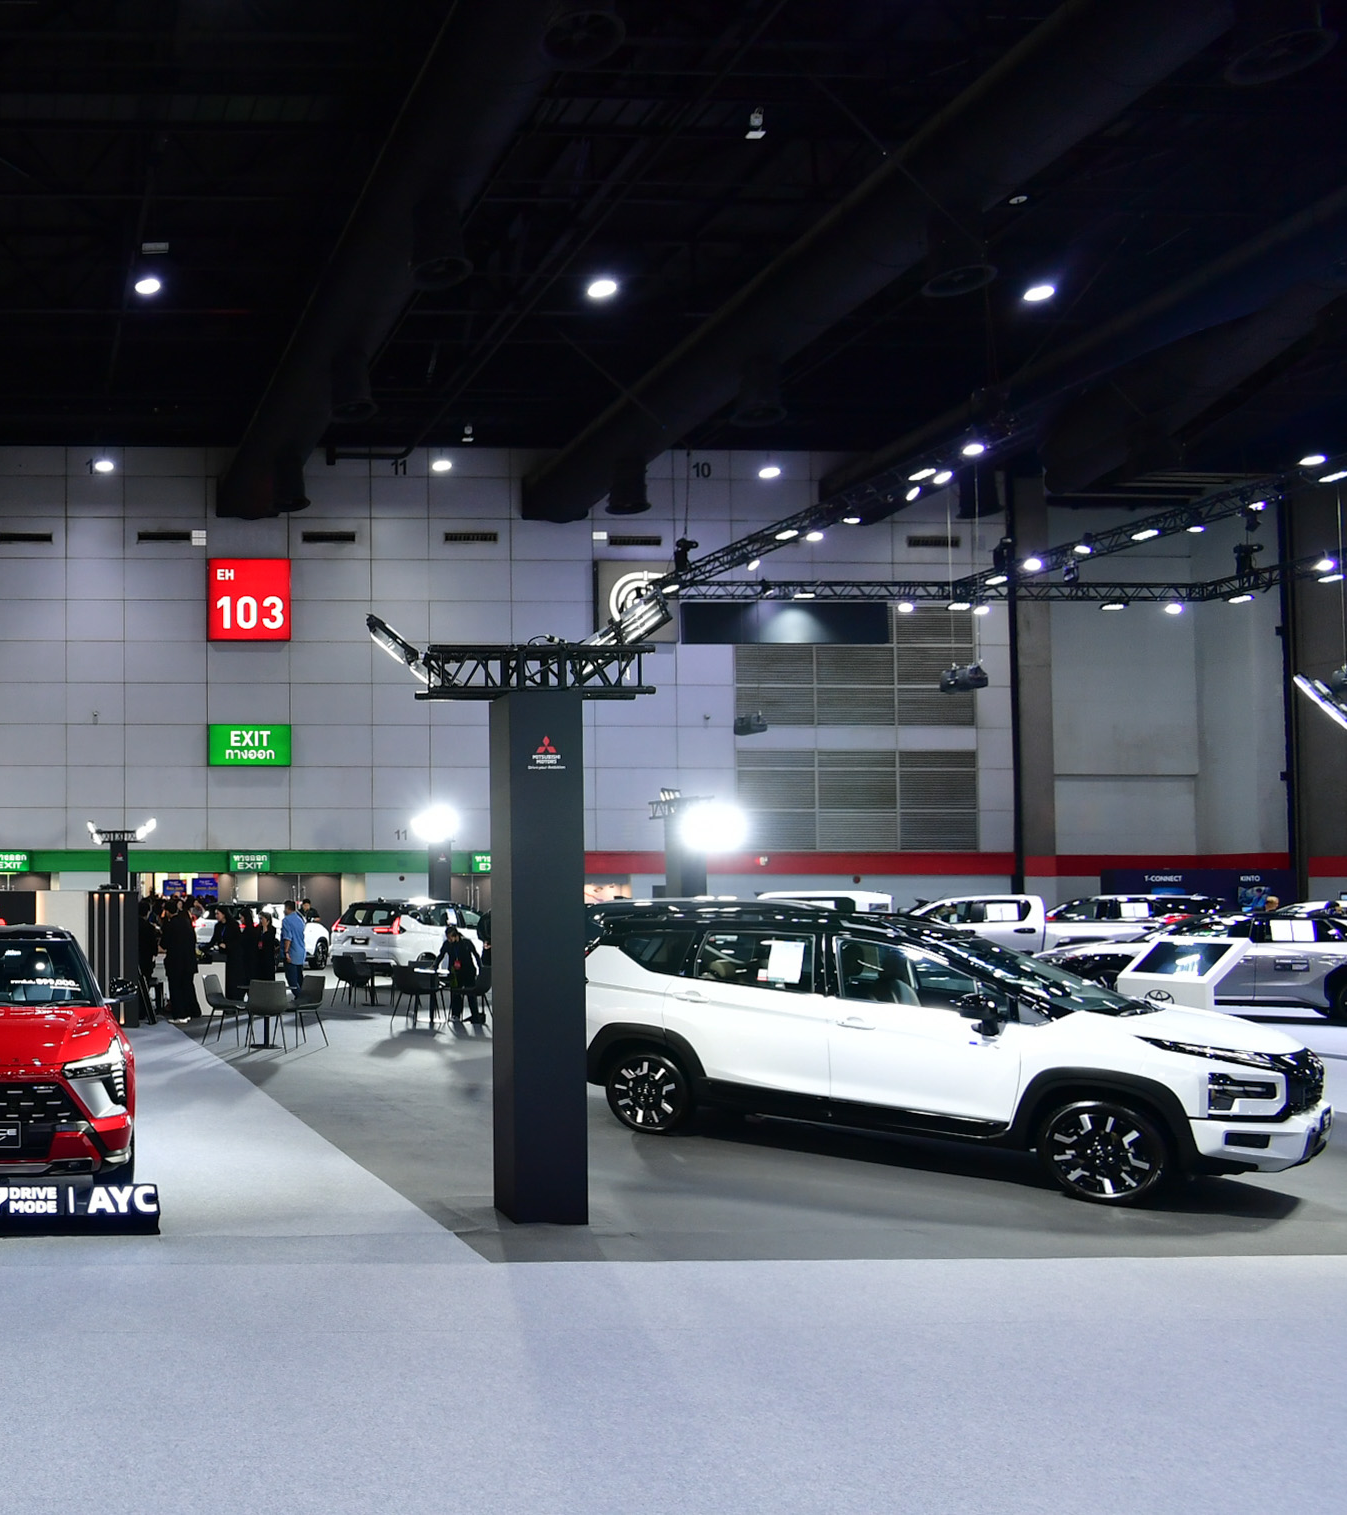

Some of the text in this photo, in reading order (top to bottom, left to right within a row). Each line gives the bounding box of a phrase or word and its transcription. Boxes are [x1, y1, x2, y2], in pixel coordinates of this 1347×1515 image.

[391, 459, 407, 475] 11
[693, 462, 711, 478] 10
[216, 569, 235, 580] EH
[216, 596, 284, 629] 103
[230, 731, 271, 747] EXIT
[225, 749, 275, 760] ทางออก
[395, 830, 407, 840] 11
[237, 862, 263, 870] EXIT
[9, 1187, 58, 1199] DRIVE
[87, 1185, 158, 1214] AYC
[9, 1201, 58, 1213] MODE
